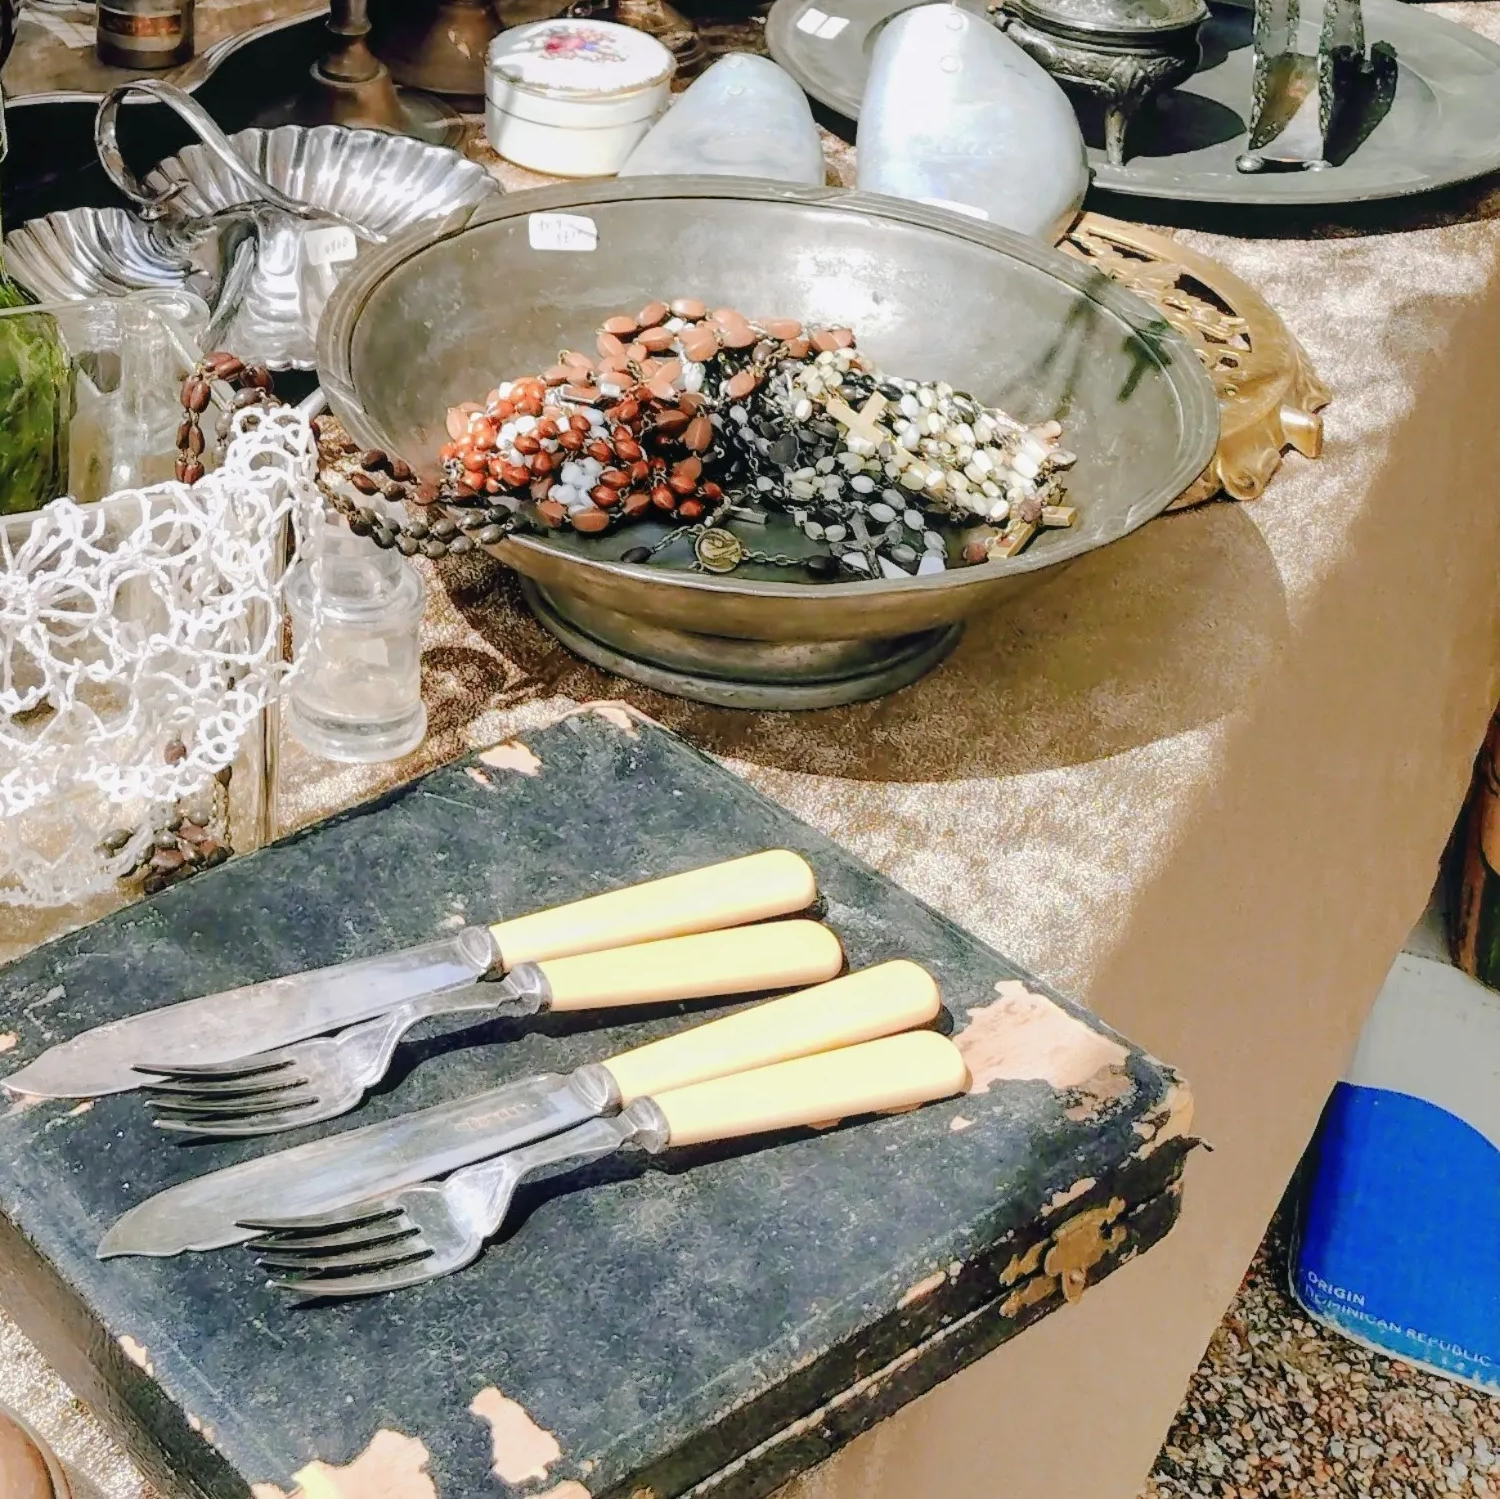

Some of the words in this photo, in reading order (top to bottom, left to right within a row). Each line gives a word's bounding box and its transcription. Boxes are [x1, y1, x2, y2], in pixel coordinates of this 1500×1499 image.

[1307, 1270, 1365, 1307] ORIGIN
[1305, 1283, 1402, 1334] DOMINICAN
[1405, 1327, 1493, 1368] REPUBLIC
